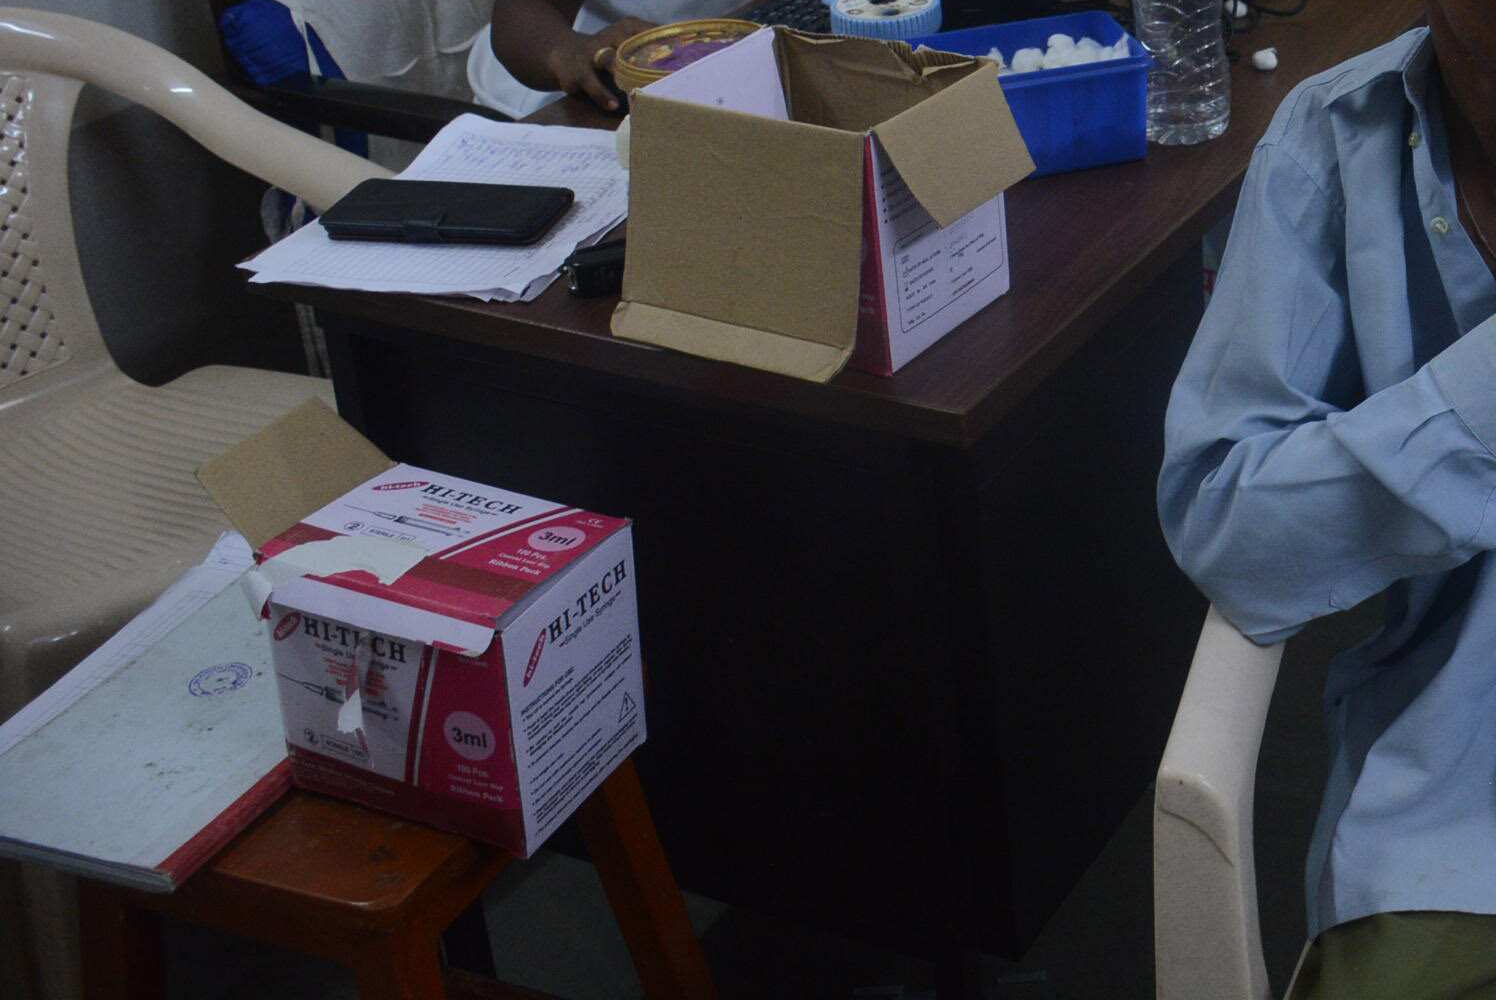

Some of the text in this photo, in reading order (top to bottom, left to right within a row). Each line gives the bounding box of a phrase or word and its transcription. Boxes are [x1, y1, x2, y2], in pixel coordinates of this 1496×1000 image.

[421, 484, 523, 516] HI-TECH
[537, 530, 577, 546] 3ml
[548, 560, 626, 643] HI-TECH
[451, 726, 488, 750] 3ml
